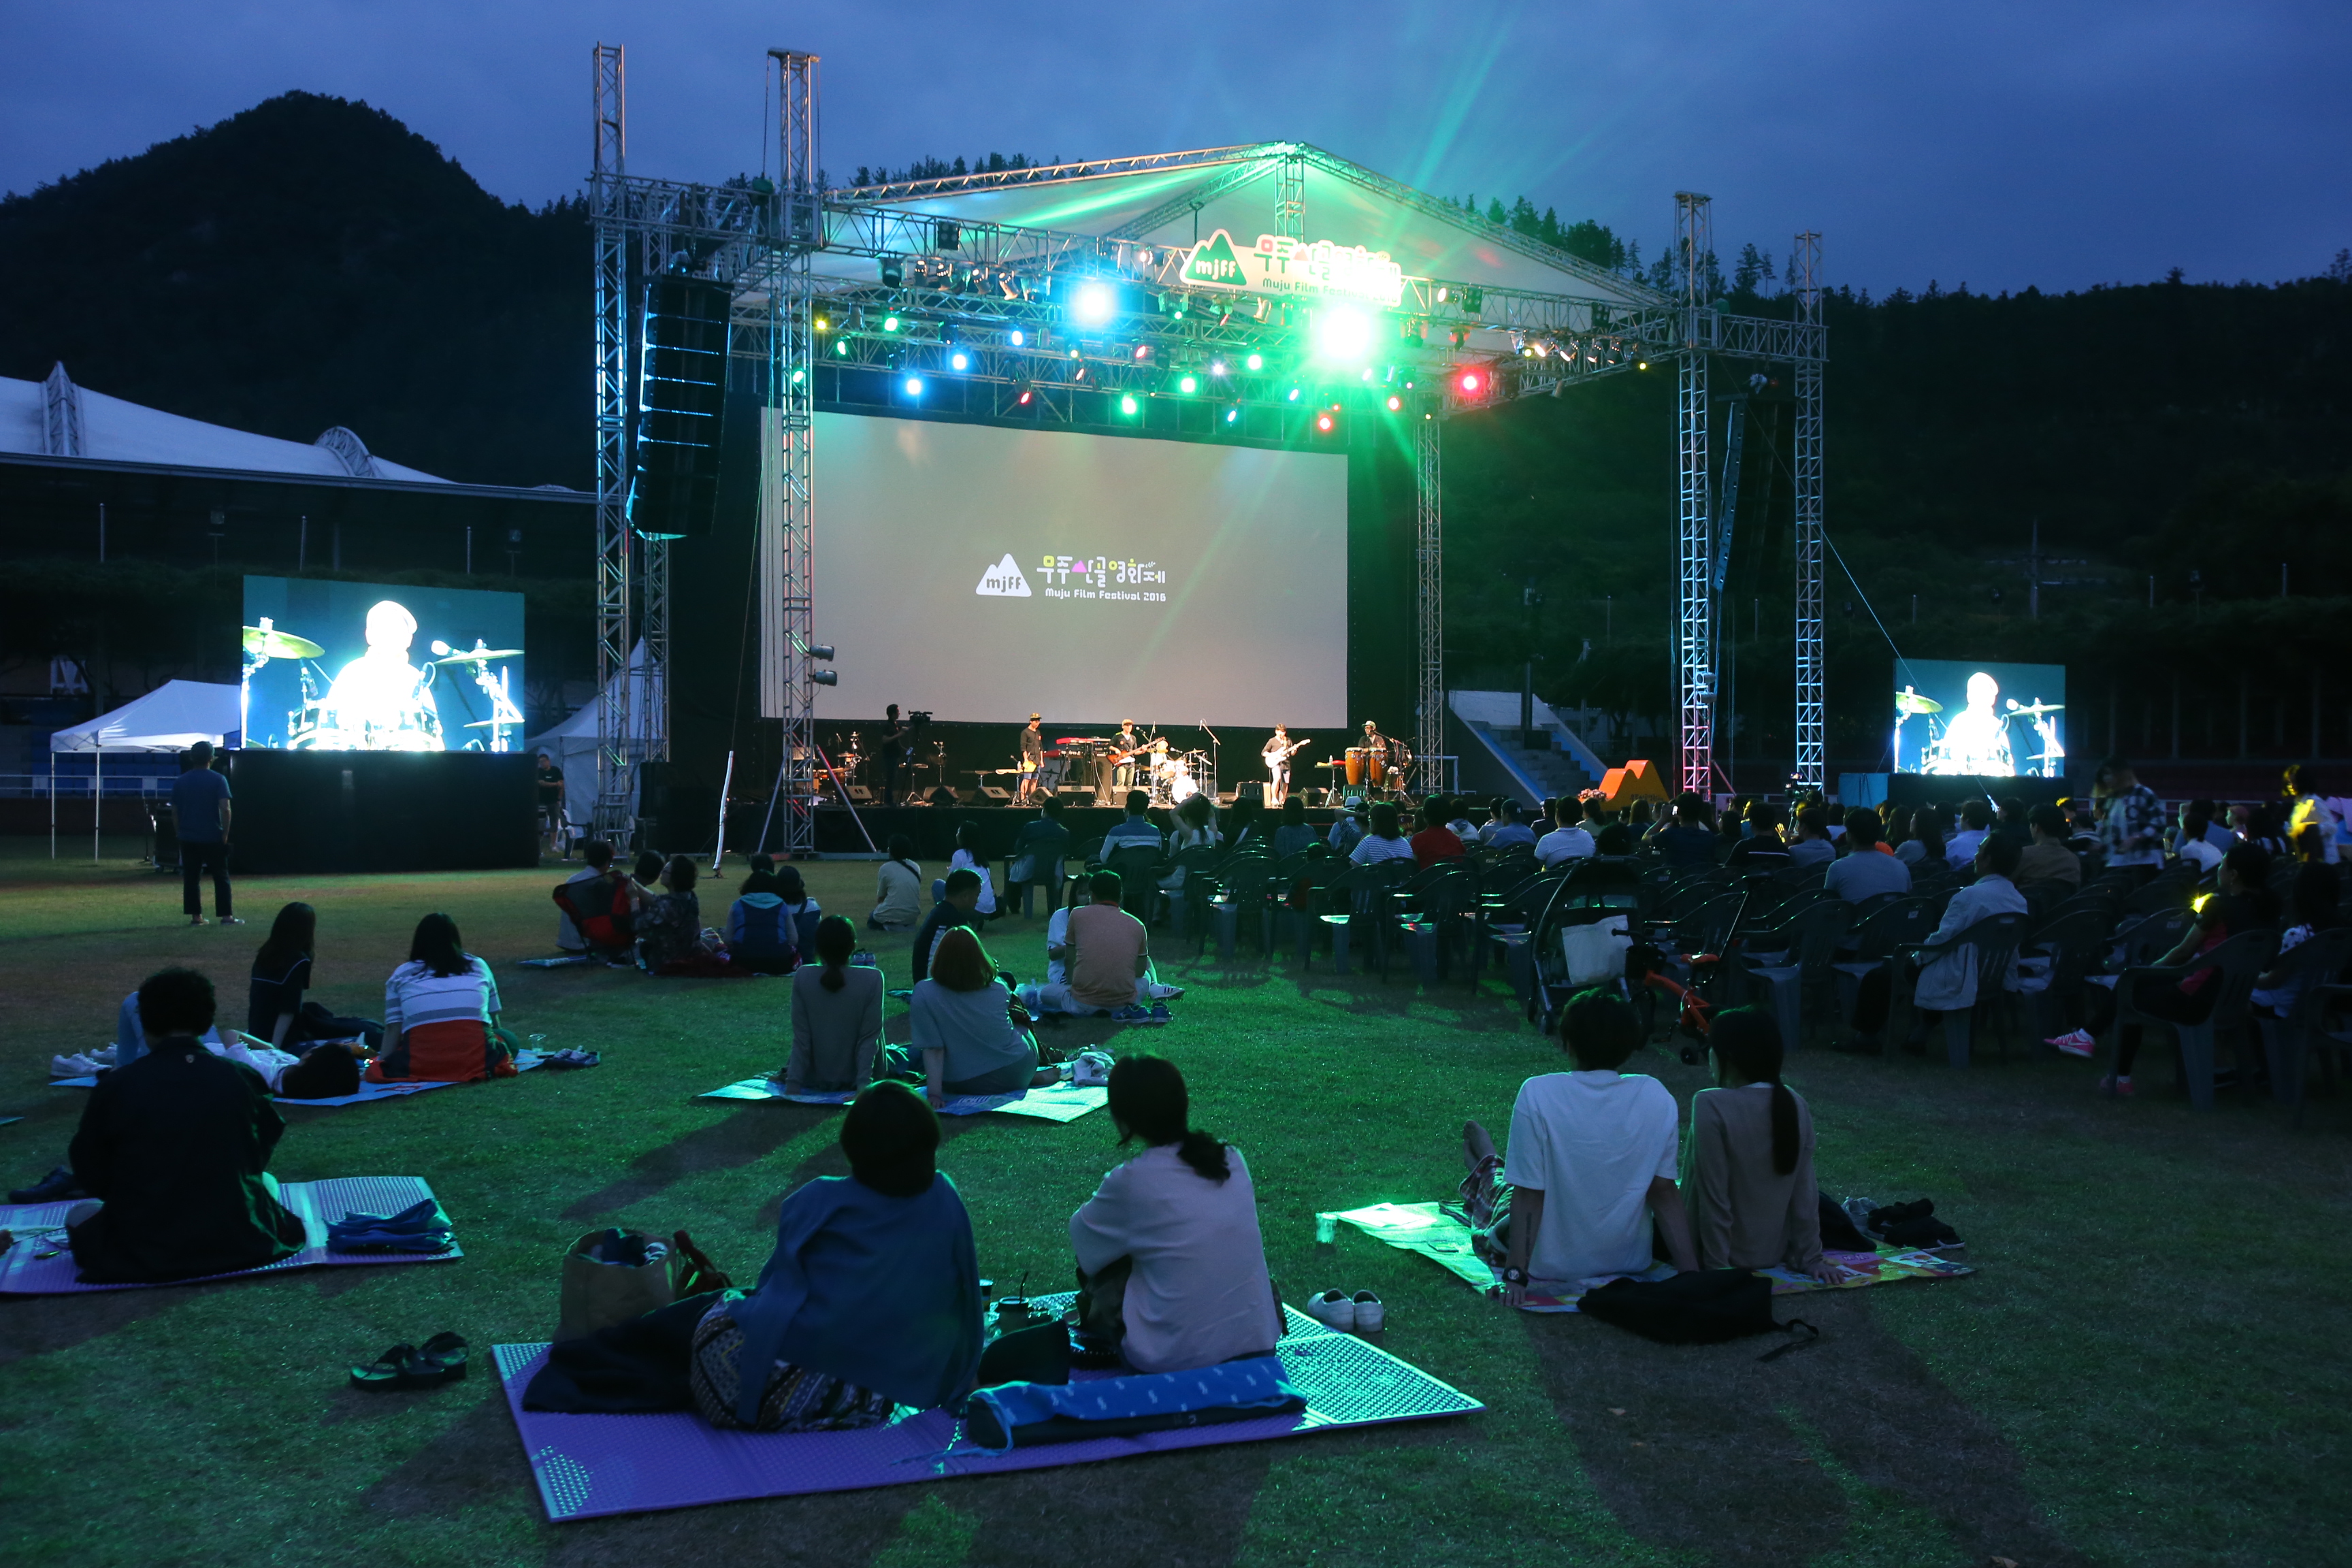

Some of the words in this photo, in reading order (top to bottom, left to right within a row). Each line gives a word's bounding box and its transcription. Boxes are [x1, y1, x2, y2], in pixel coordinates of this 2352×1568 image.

[1195, 259, 1237, 280] mjff
[1262, 278, 1290, 291] Muju
[1295, 282, 1318, 294] Film
[1324, 285, 1369, 299] Festival
[1036, 555, 1166, 588] 무주산골영화제
[986, 576, 1022, 592] mjff
[1045, 587, 1071, 600] Muju
[1074, 589, 1096, 599] Film
[1099, 590, 1141, 601] Festival
[1143, 591, 1166, 602] 2016
